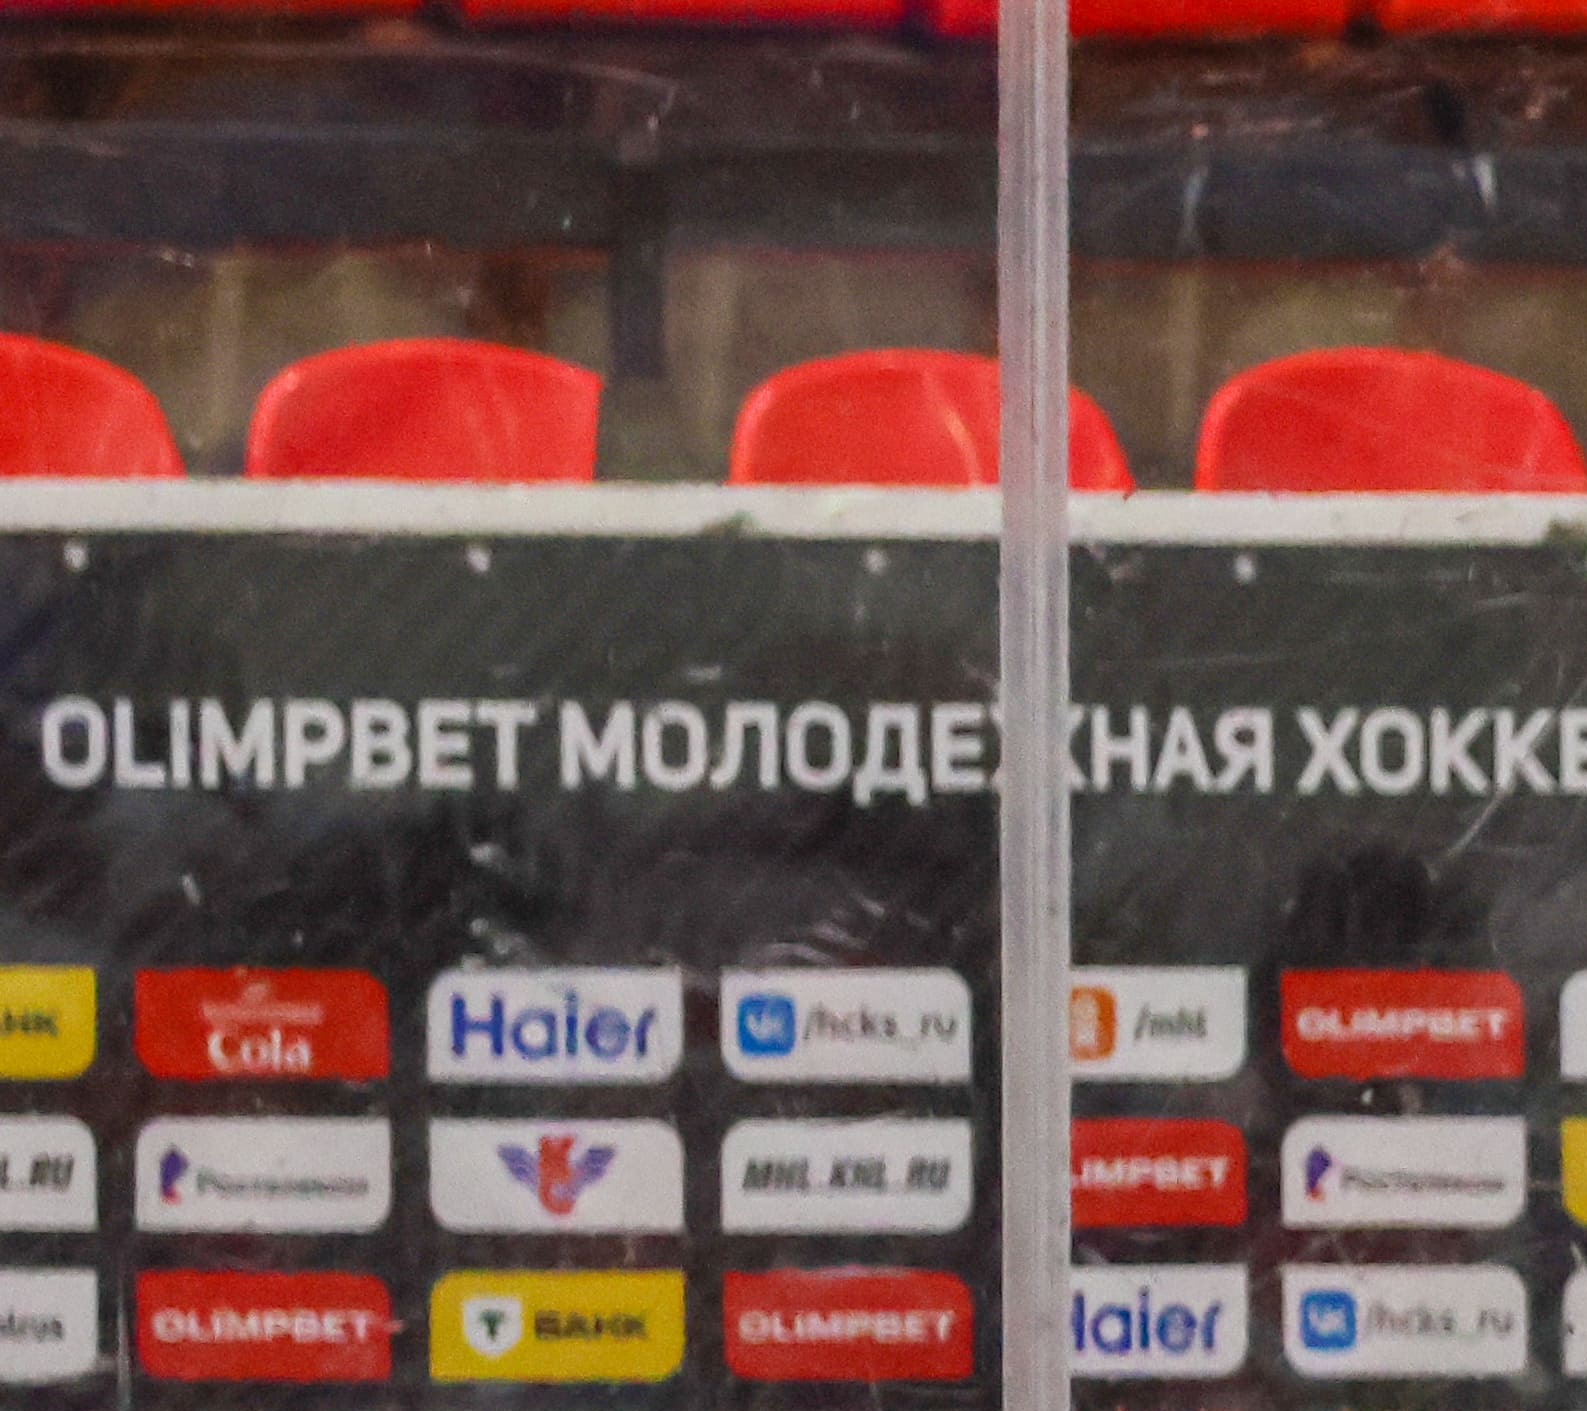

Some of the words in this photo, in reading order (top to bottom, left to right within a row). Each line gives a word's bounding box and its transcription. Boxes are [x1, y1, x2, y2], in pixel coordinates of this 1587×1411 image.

[41, 695, 537, 792] OLIMPBET
[450, 993, 656, 1061] Haier
[1297, 1006, 1509, 1042] OLIMPBET
[207, 1028, 312, 1077] Cola
[1071, 1157, 1229, 1190] IMPBET
[151, 1306, 373, 1344] OLIMPBET
[737, 1306, 954, 1345] OLIMPBET
